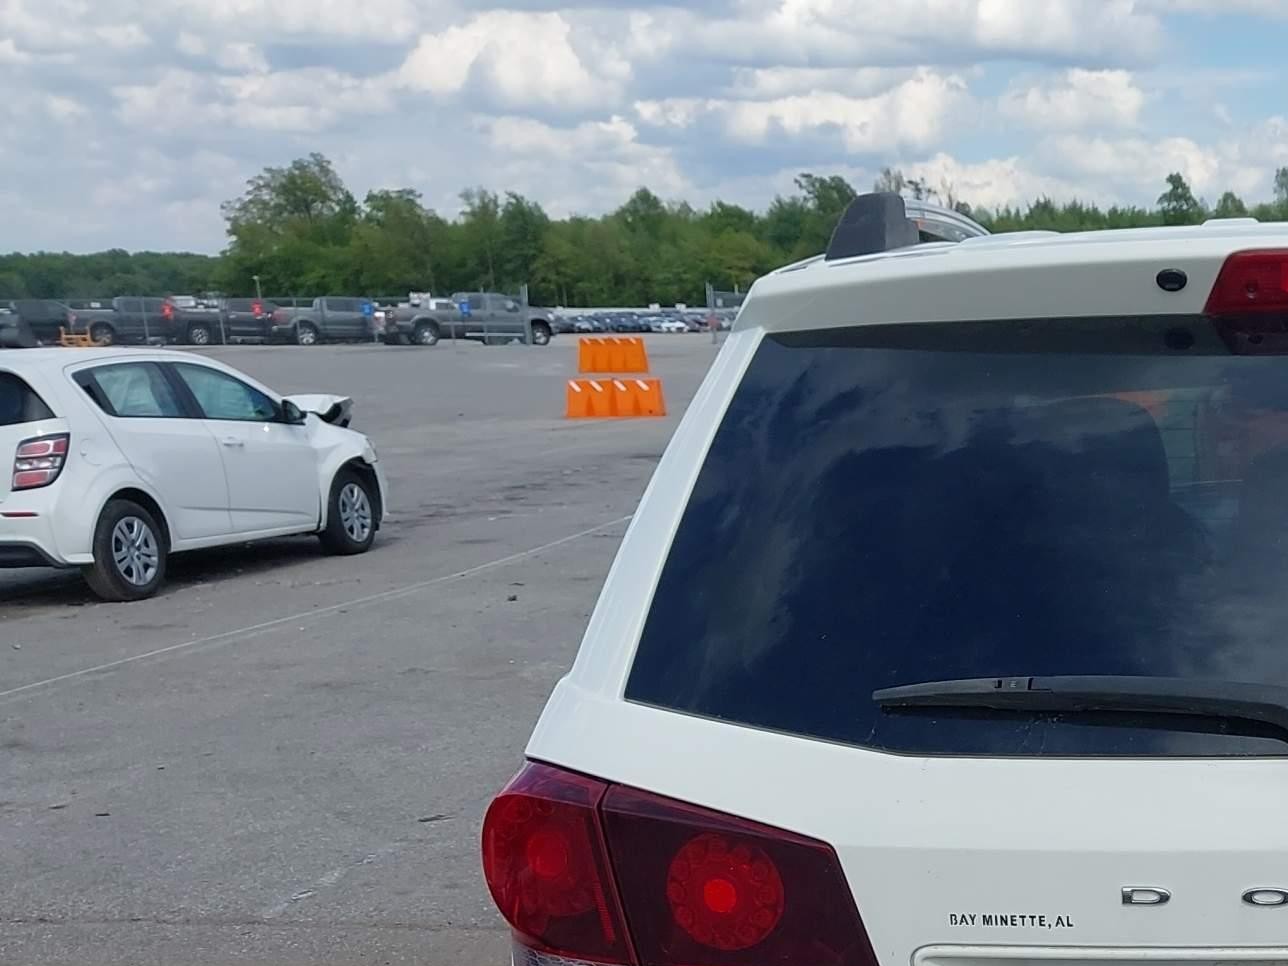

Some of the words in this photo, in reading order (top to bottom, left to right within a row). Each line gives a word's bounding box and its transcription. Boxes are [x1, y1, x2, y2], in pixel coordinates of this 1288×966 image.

[949, 913, 976, 926] BAY
[982, 914, 1052, 929] MINETTE,
[1055, 915, 1075, 928] AL
